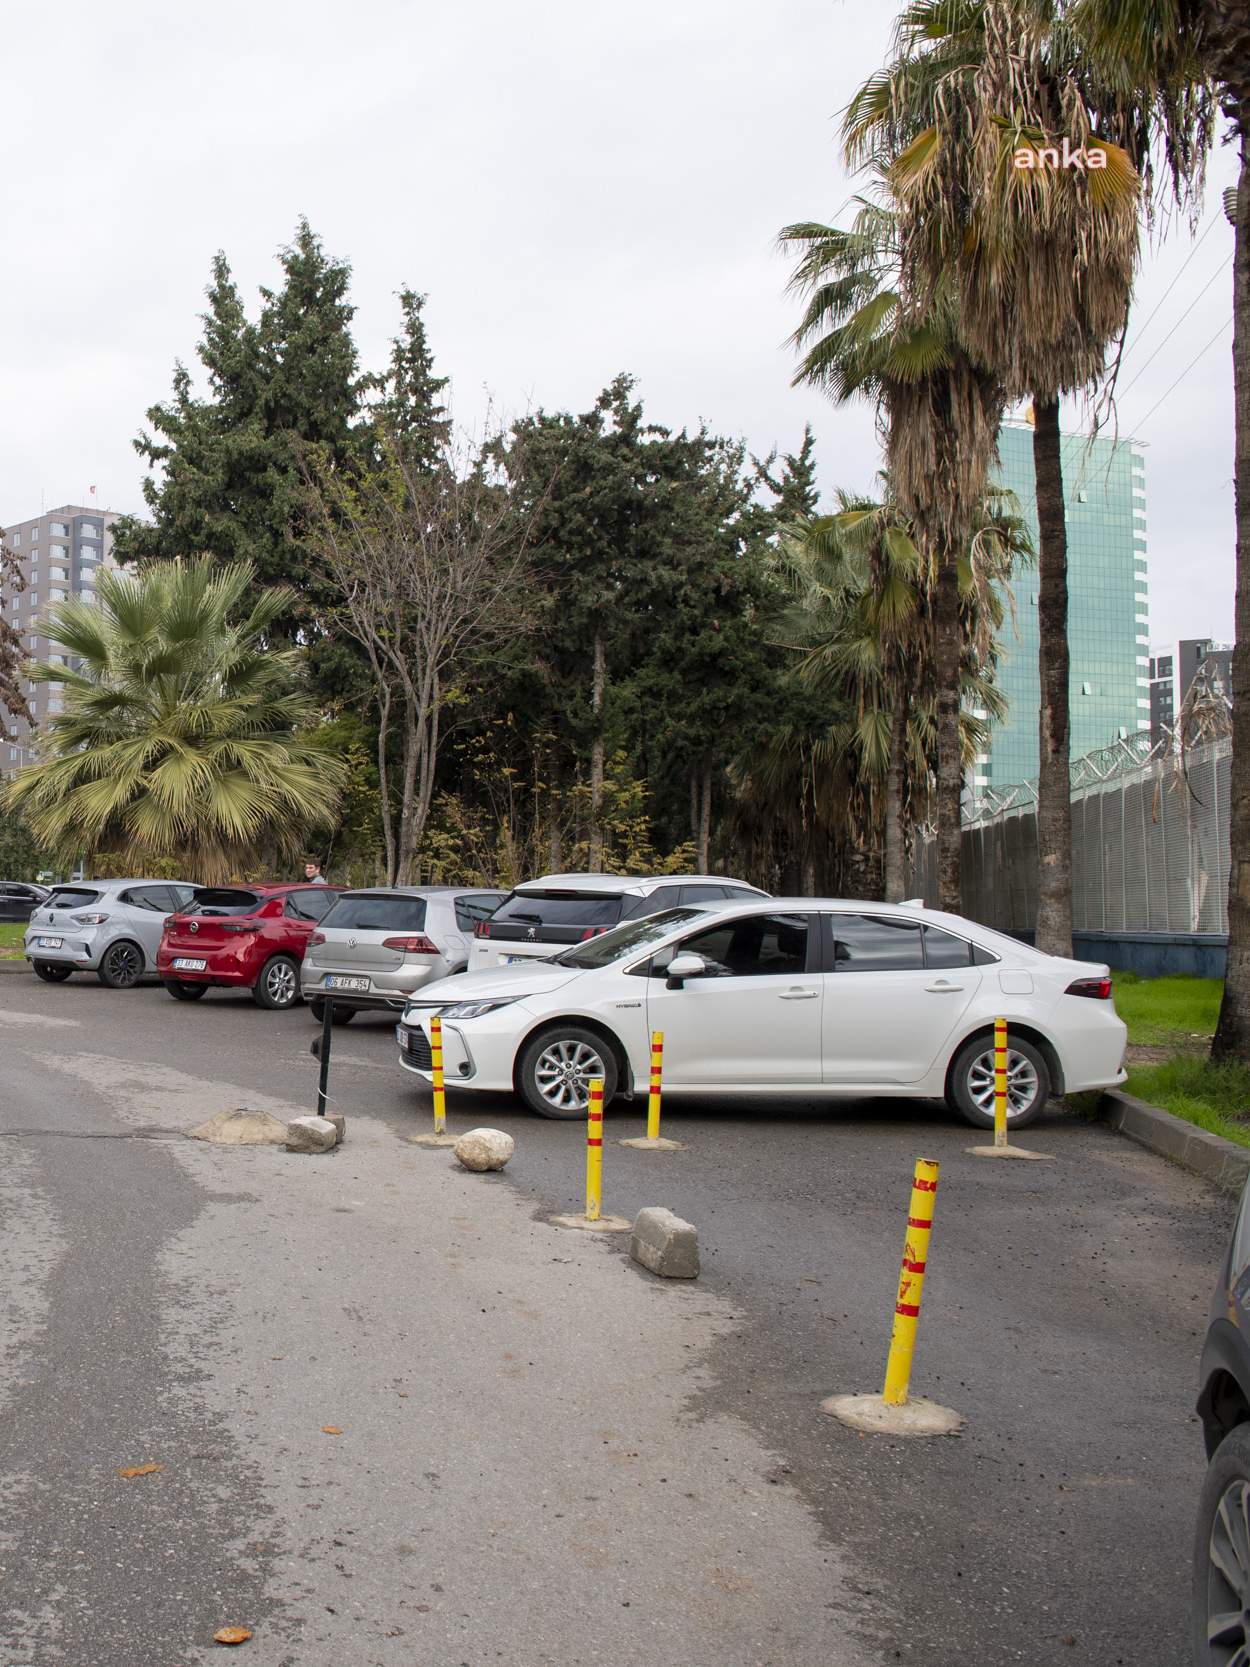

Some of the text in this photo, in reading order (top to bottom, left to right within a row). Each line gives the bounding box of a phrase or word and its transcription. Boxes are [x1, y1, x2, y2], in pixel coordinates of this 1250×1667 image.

[330, 977, 368, 989] 06 AFK 354
